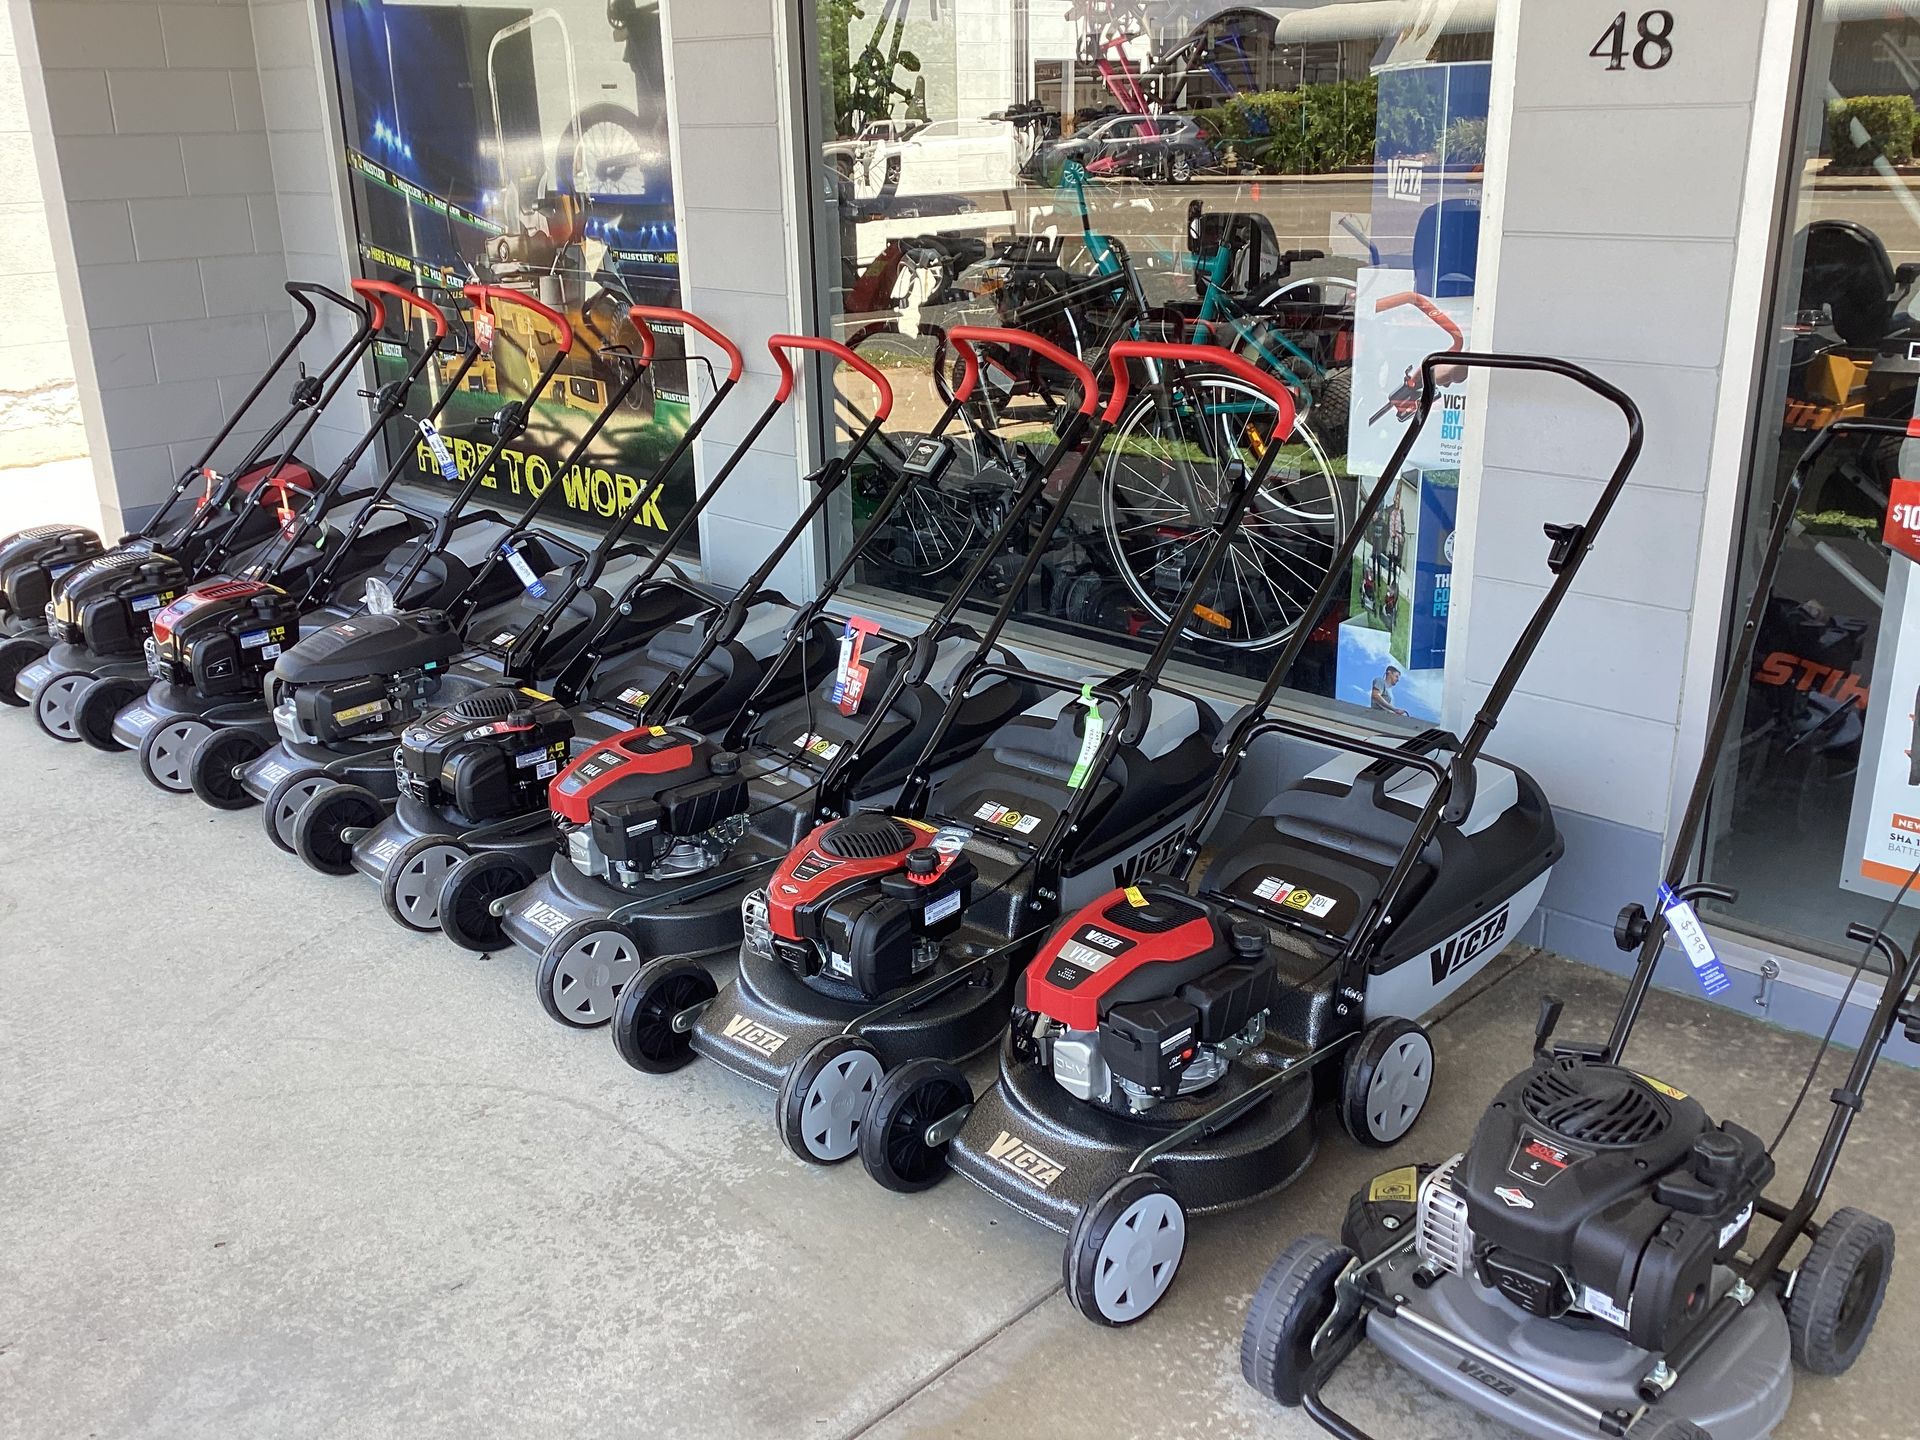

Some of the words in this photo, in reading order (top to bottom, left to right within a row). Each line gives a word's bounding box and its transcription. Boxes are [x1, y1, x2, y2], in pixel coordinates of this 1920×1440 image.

[1589, 10, 1674, 71] 48
[1387, 158, 1423, 203] VICTA
[620, 251, 654, 263] HUSTLER
[1443, 410, 1461, 424] 18V
[501, 448, 552, 500] TO
[557, 460, 670, 532] WORK
[1434, 573, 1451, 589] TH
[1889, 832, 1912, 845] SHA
[521, 899, 573, 938] VICTA
[1068, 945, 1102, 967] V144
[1084, 929, 1124, 950] VICTA
[1430, 902, 1510, 987] VICTA
[722, 1013, 792, 1058] VICTA
[985, 1130, 1067, 1190] VICTA
[1457, 1358, 1517, 1397] VICTA
